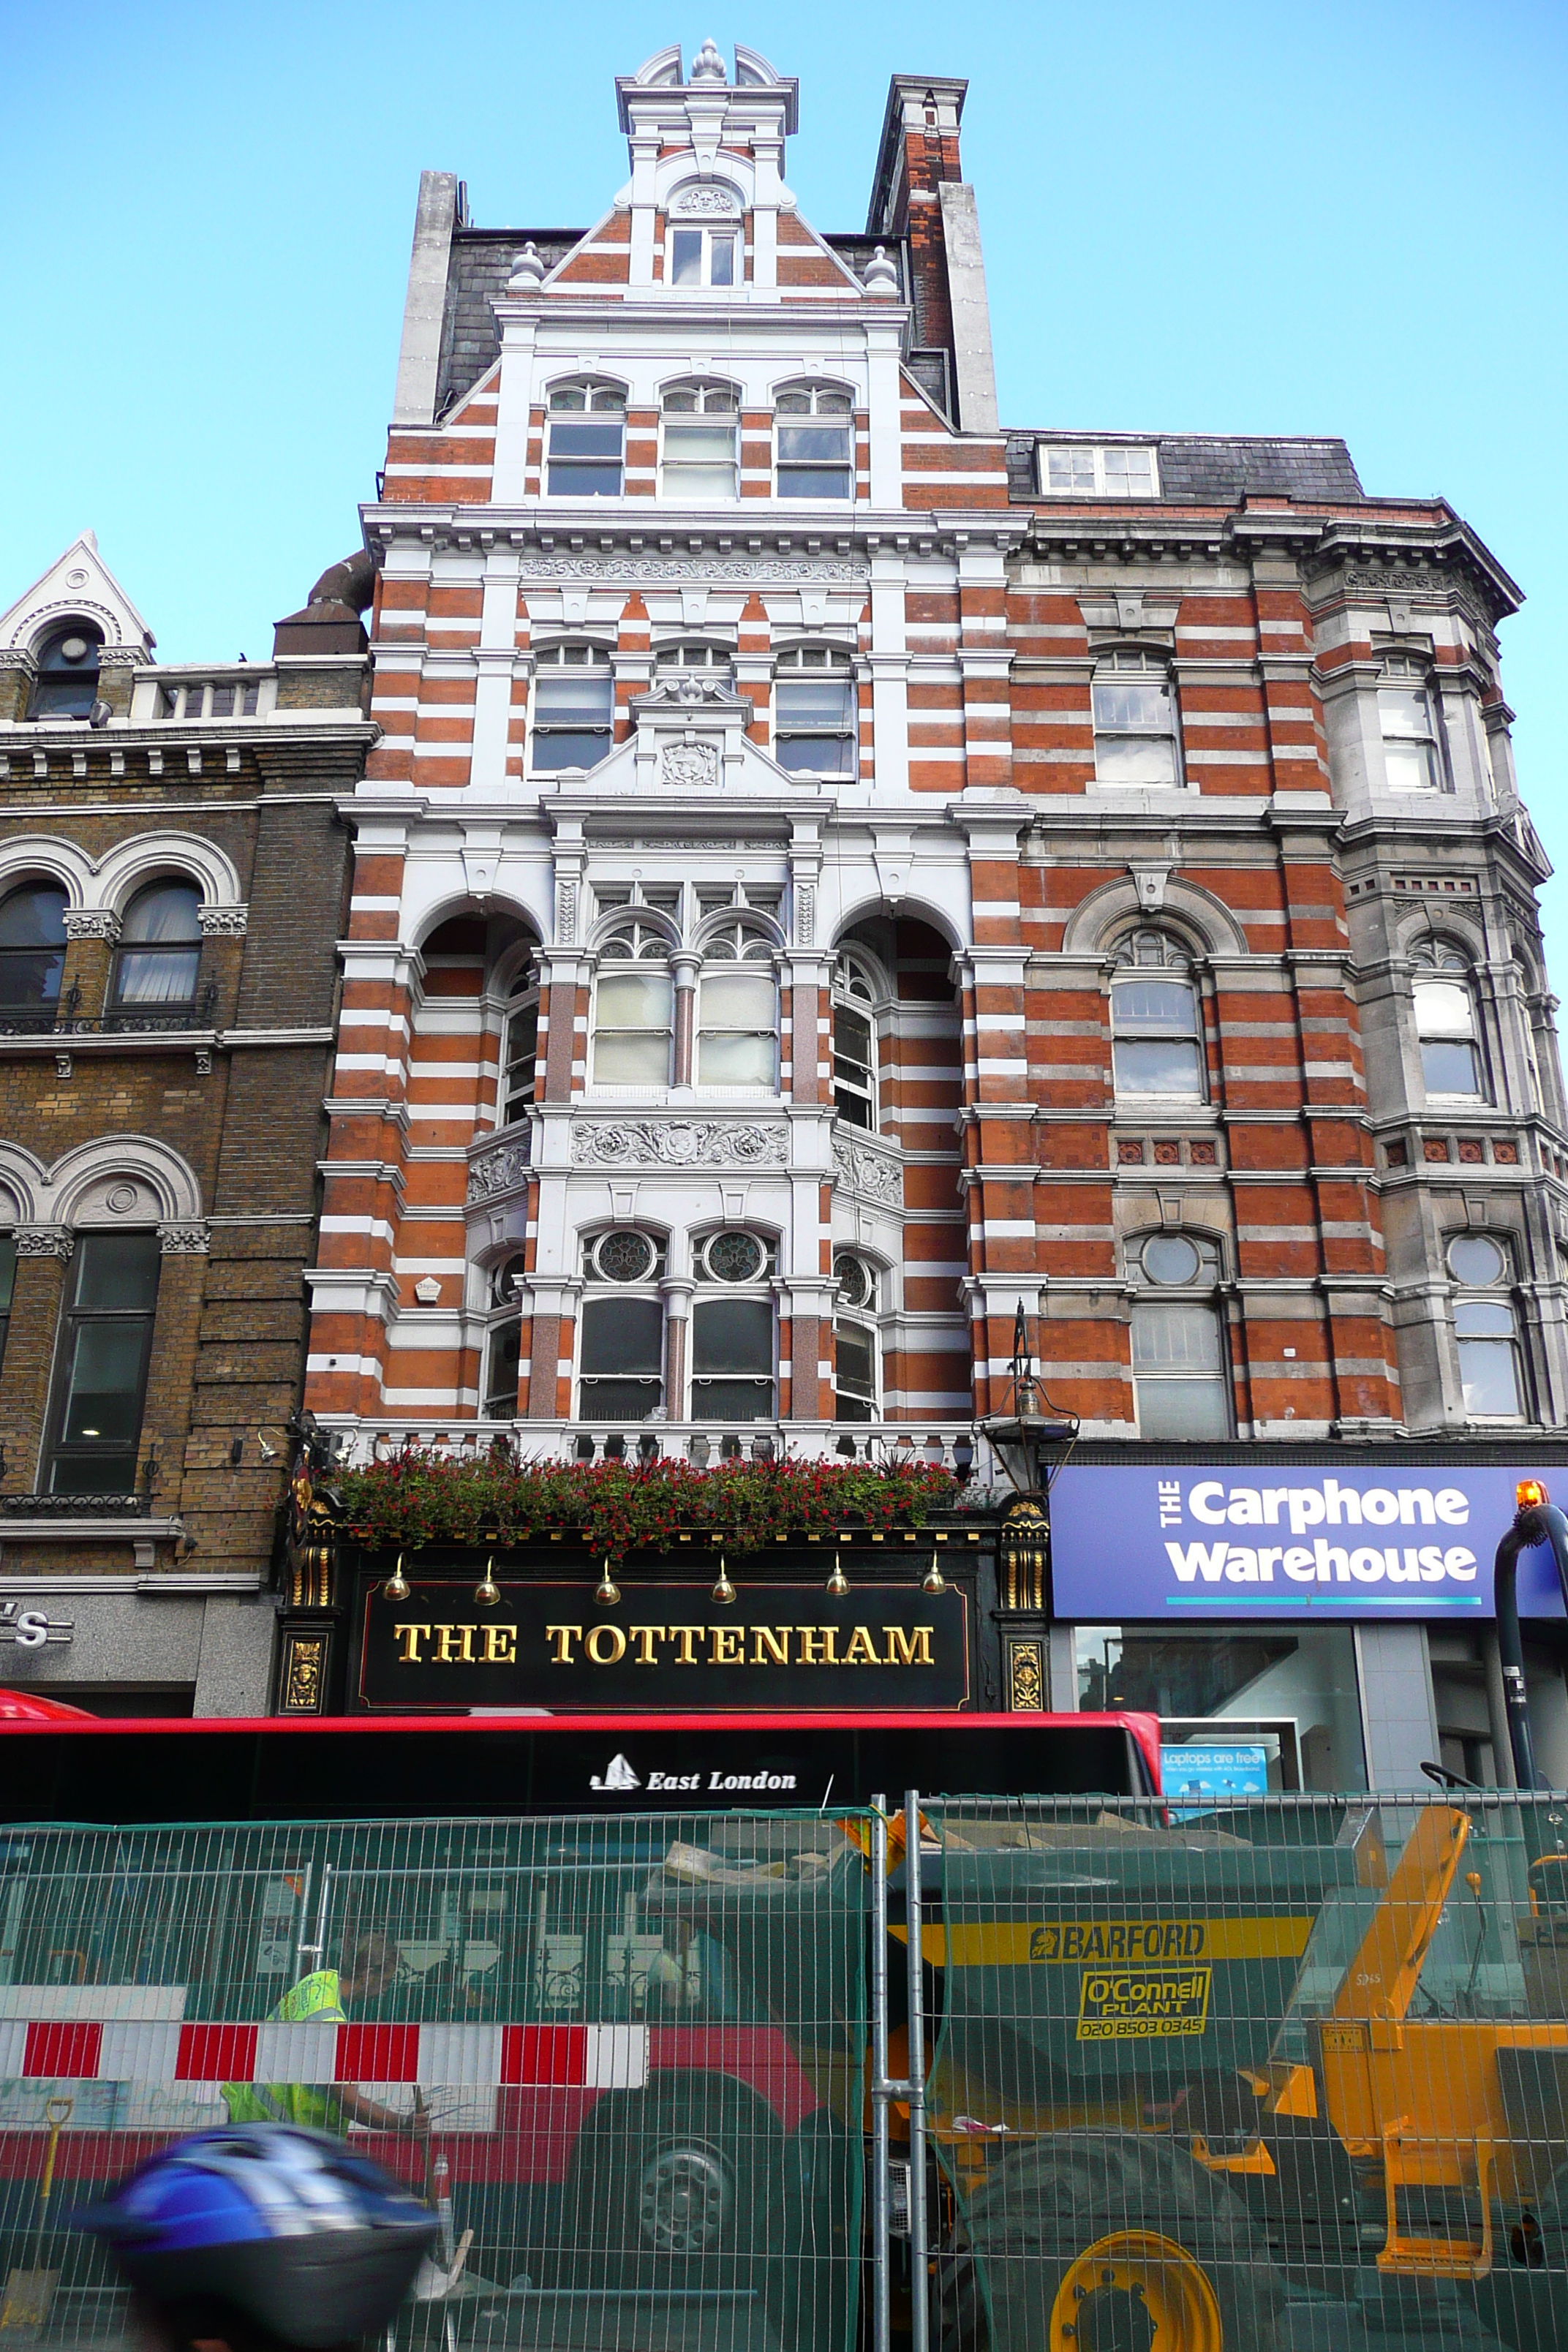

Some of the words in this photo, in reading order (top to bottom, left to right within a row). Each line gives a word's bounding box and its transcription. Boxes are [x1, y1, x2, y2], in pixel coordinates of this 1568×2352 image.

[1158, 1480, 1183, 1529] THE
[1188, 1479, 1470, 1534] Carphone
[1164, 1538, 1477, 1583] Warehouse
[393, 1624, 518, 1664] THE
[545, 1624, 935, 1665] TOTTENHAM
[1164, 1752, 1211, 1767] Laptops
[1213, 1754, 1234, 1764] are
[1236, 1752, 1260, 1764] free
[646, 1772, 701, 1790] East
[707, 1771, 797, 1790] London
[1063, 1924, 1205, 1959] BARFORD
[1088, 1976, 1204, 2002] O'Connell
[1101, 2001, 1188, 2016] PLANT
[1080, 2023, 1113, 2036] 020
[1116, 2021, 1158, 2035] 8503
[1161, 2019, 1202, 2033] 0345
